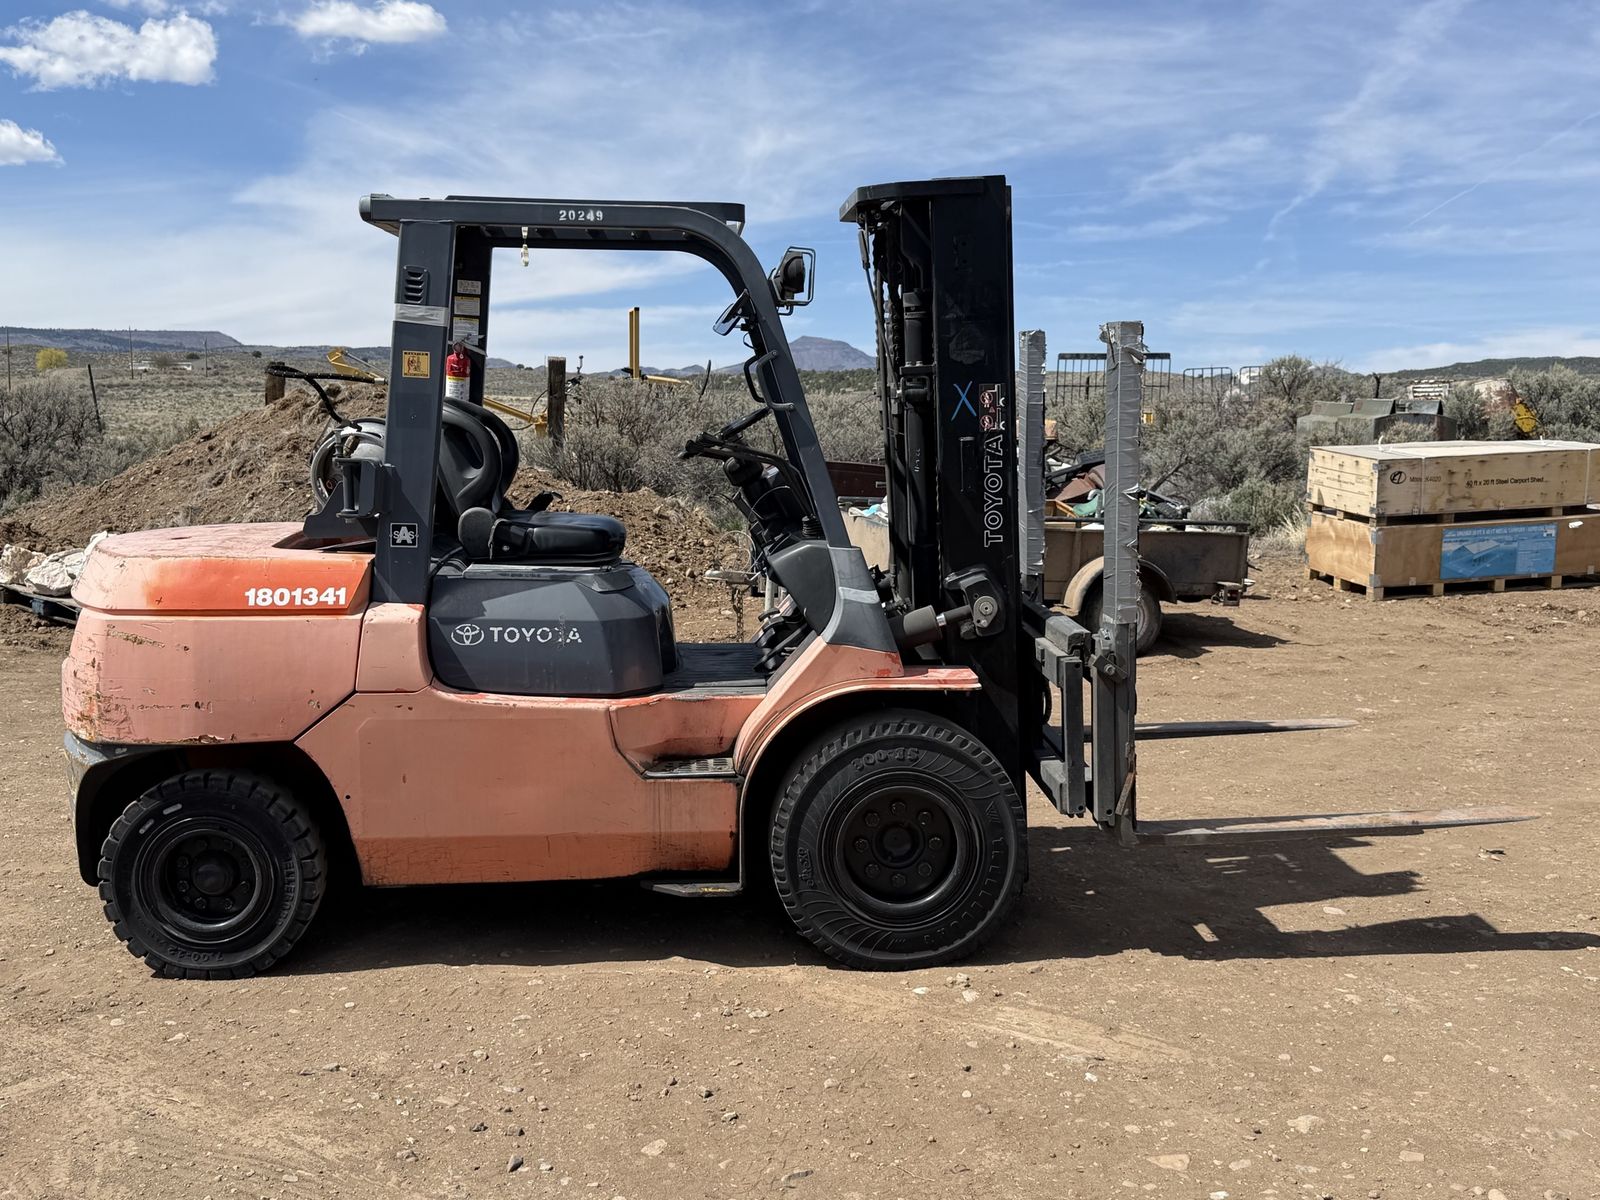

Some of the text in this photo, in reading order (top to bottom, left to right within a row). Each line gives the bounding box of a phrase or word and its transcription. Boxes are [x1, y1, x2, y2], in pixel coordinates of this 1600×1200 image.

[558, 209, 604, 222] 20249
[1496, 477, 1509, 485] Steel
[1510, 477, 1530, 485] Carport
[983, 434, 1004, 548] TOYOTA
[244, 587, 347, 607] 1801341
